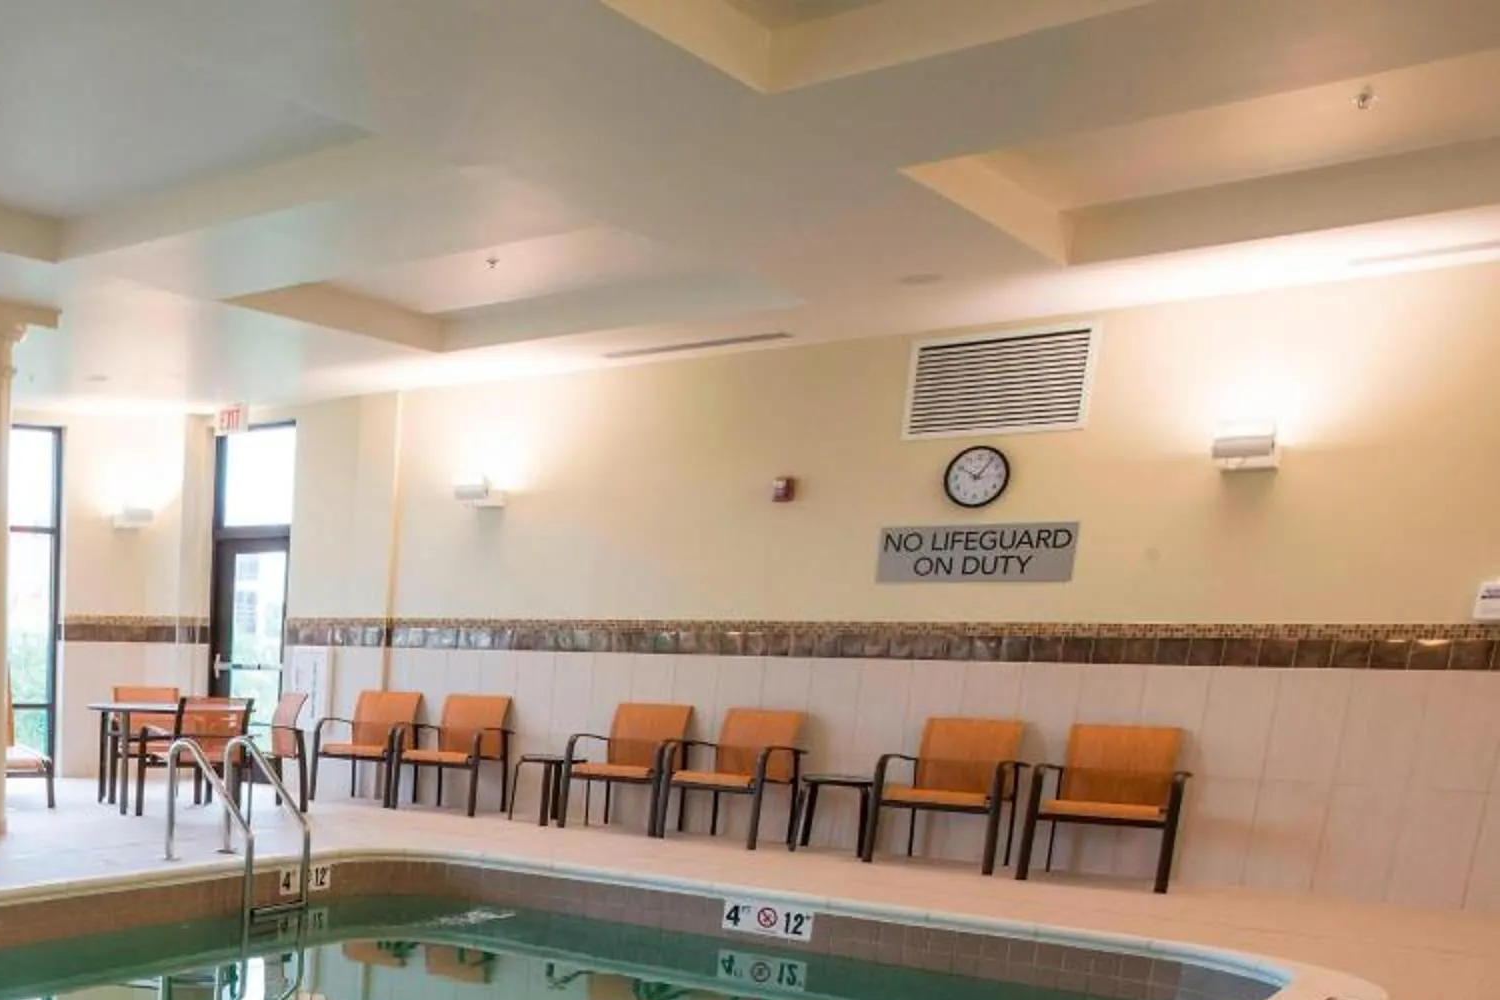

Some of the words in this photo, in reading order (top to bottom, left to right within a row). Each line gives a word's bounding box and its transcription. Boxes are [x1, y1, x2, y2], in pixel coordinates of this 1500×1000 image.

[884, 532, 923, 552] NO
[931, 529, 1073, 551] LIFEGUARD
[913, 556, 953, 576] ON
[961, 554, 1033, 576] DUTY
[726, 905, 740, 926] 4
